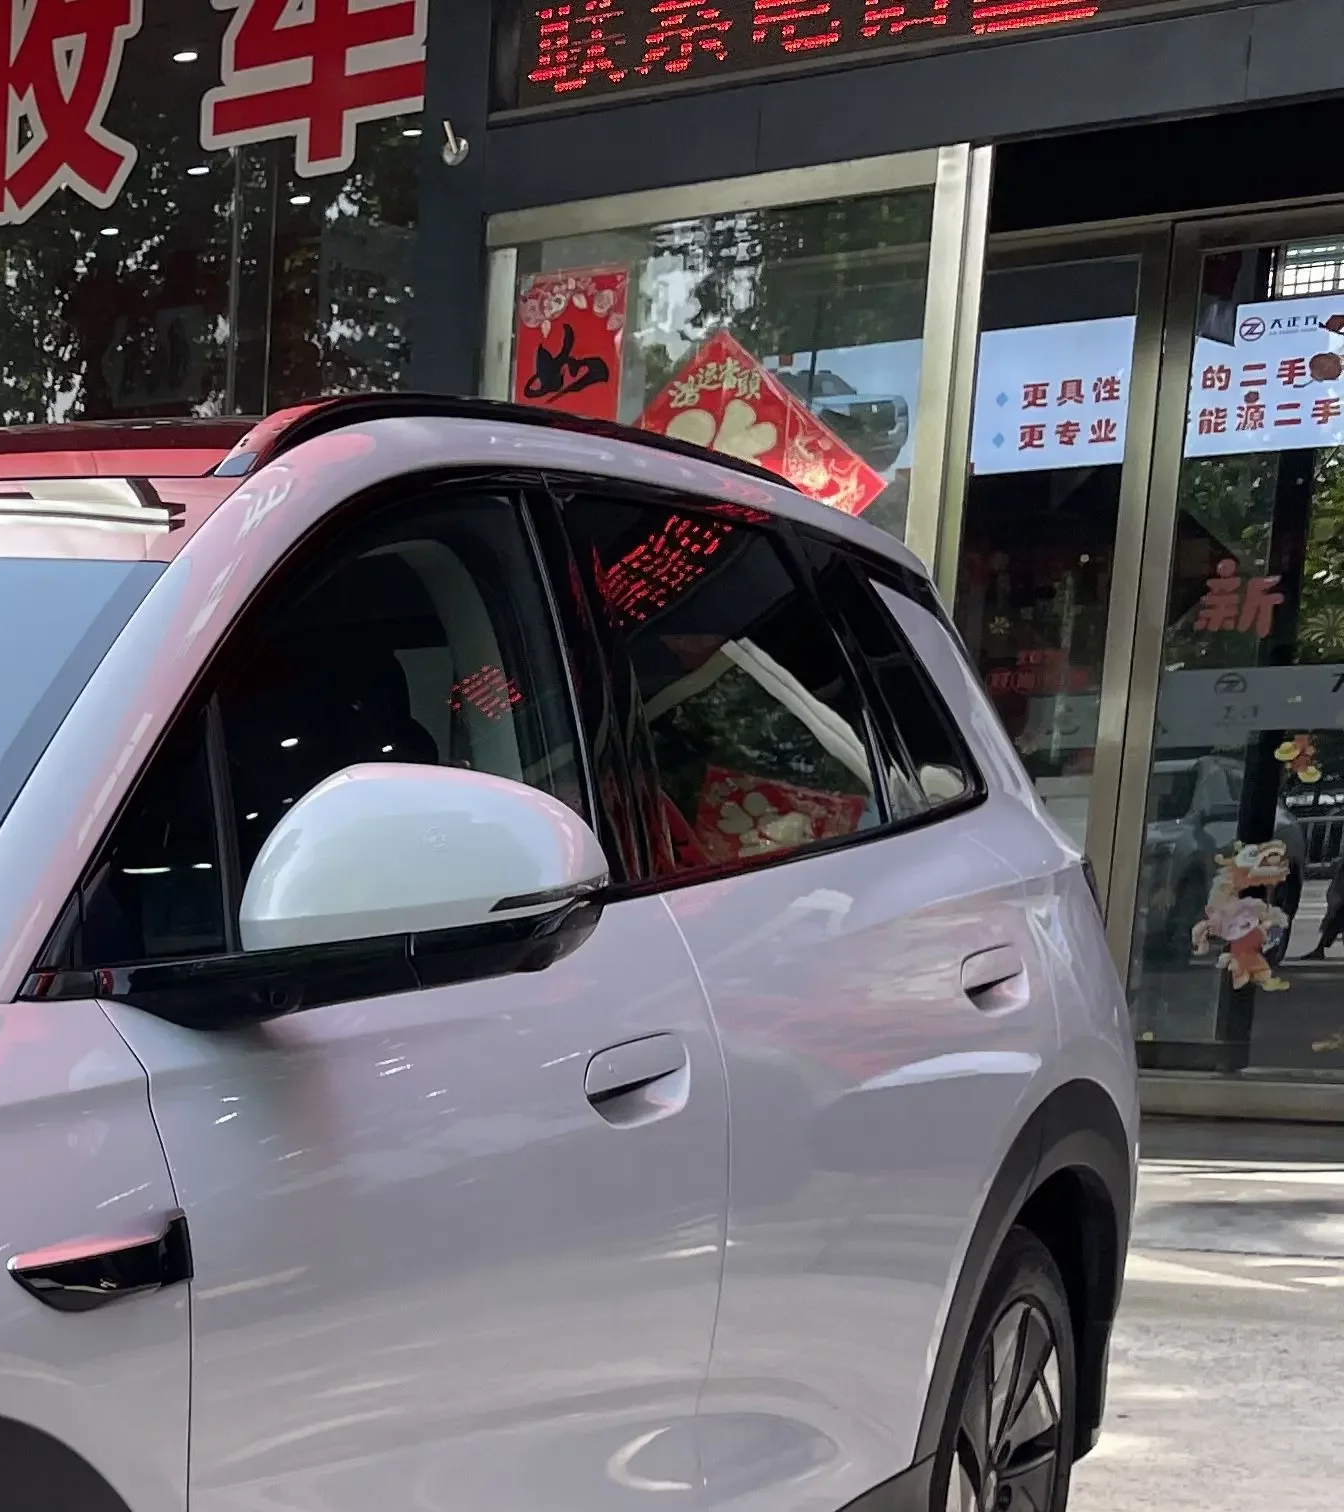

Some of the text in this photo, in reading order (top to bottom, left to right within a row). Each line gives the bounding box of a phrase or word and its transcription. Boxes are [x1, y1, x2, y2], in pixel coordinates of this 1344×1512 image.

[1021, 376, 1121, 410] 更具性
[1018, 418, 1118, 451] 更专业
[1193, 557, 1286, 638] 新
